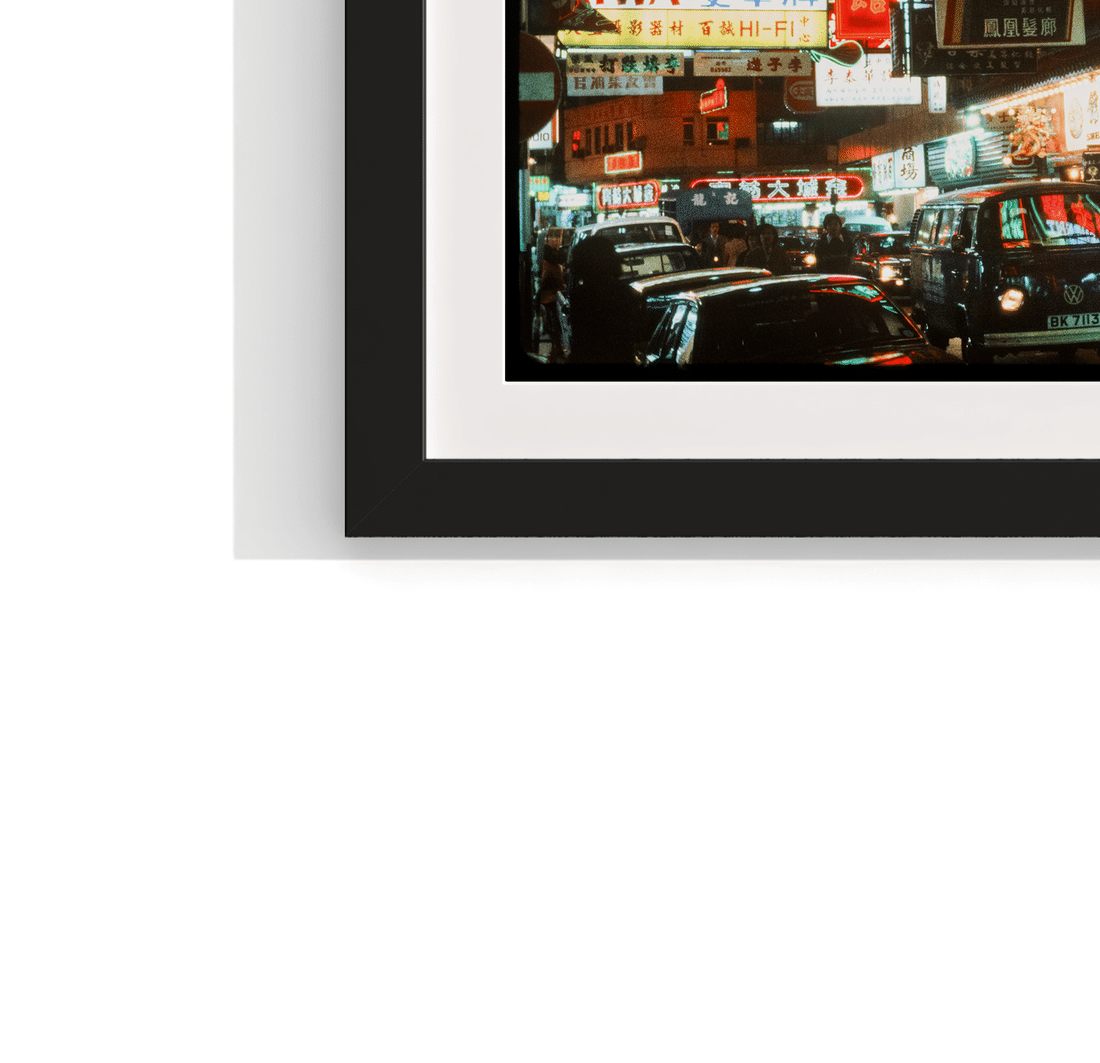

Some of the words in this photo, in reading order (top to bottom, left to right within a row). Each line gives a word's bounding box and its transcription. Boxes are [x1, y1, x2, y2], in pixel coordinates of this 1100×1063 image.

[740, 20, 794, 37] HI-FI
[983, 17, 1057, 38] 鳳凰髮廊
[1050, 316, 1069, 328] BK
[1073, 313, 1100, 326] 7113
